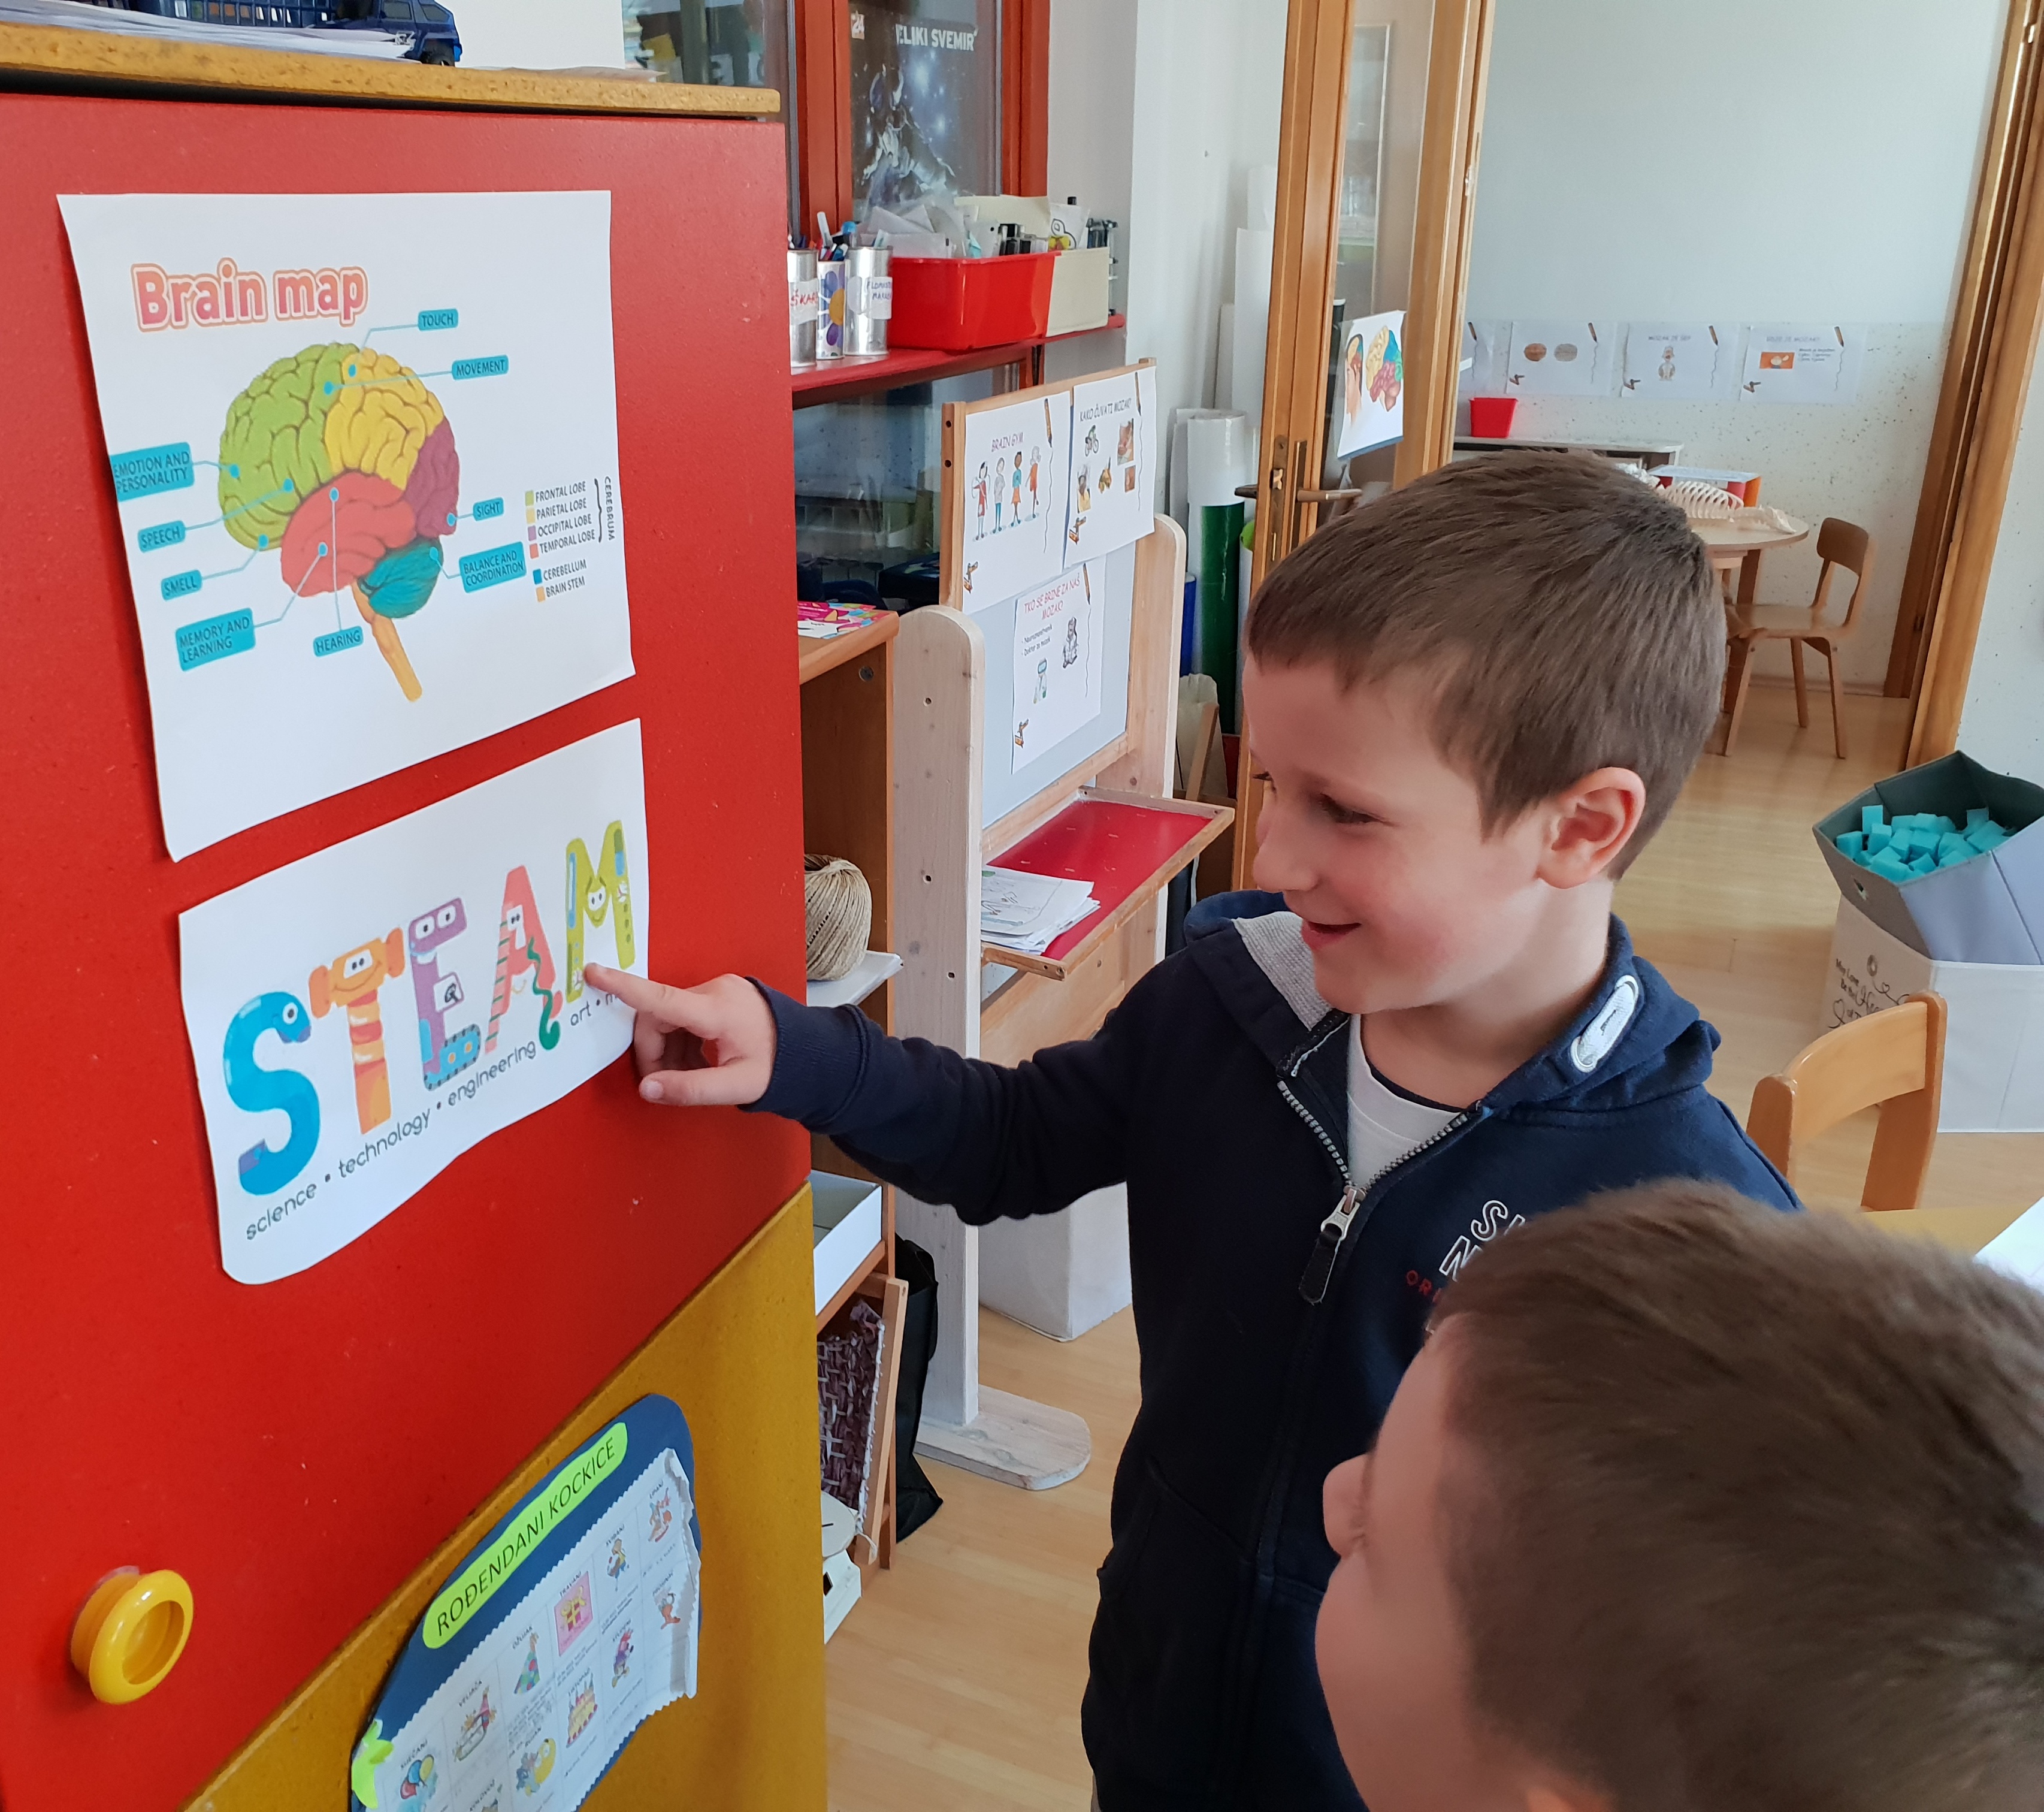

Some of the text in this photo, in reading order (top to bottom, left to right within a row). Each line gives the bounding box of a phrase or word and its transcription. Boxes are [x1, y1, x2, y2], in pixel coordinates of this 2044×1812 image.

[932, 29, 975, 52] SVEMIR
[131, 258, 368, 331] Brain map
[421, 313, 453, 327] TOUCH
[456, 360, 505, 376] MOVEMENT
[991, 436, 1011, 452] BRAIN
[113, 451, 190, 478] EMOTION AND
[116, 467, 188, 493] PERSONALITY
[536, 481, 586, 503] FRONTAL LOBE
[476, 502, 500, 517] SIGHT
[537, 498, 587, 520] PARIETAL LOBE
[604, 476, 615, 541] CEREBRUM
[141, 526, 180, 549] SPEECH
[538, 514, 592, 537] OCCIPITAL LOBE
[539, 529, 595, 554] TEMPORAL LOBE
[464, 550, 518, 575] BALANCE AND
[465, 561, 524, 587] COORDINATION
[543, 558, 587, 581] CEREBELLUM
[164, 575, 198, 597] SMELL
[546, 576, 585, 598] BRAIN STEM
[180, 616, 250, 648] MEMORY AND
[315, 630, 360, 654] HEARING
[182, 636, 232, 663] LEARNING
[223, 820, 636, 1196] STEAM
[246, 1000, 592, 1240] science technology engineering art
[437, 1511, 545, 1636] ROĐENDANI
[549, 1436, 615, 1520] KOCKICE
